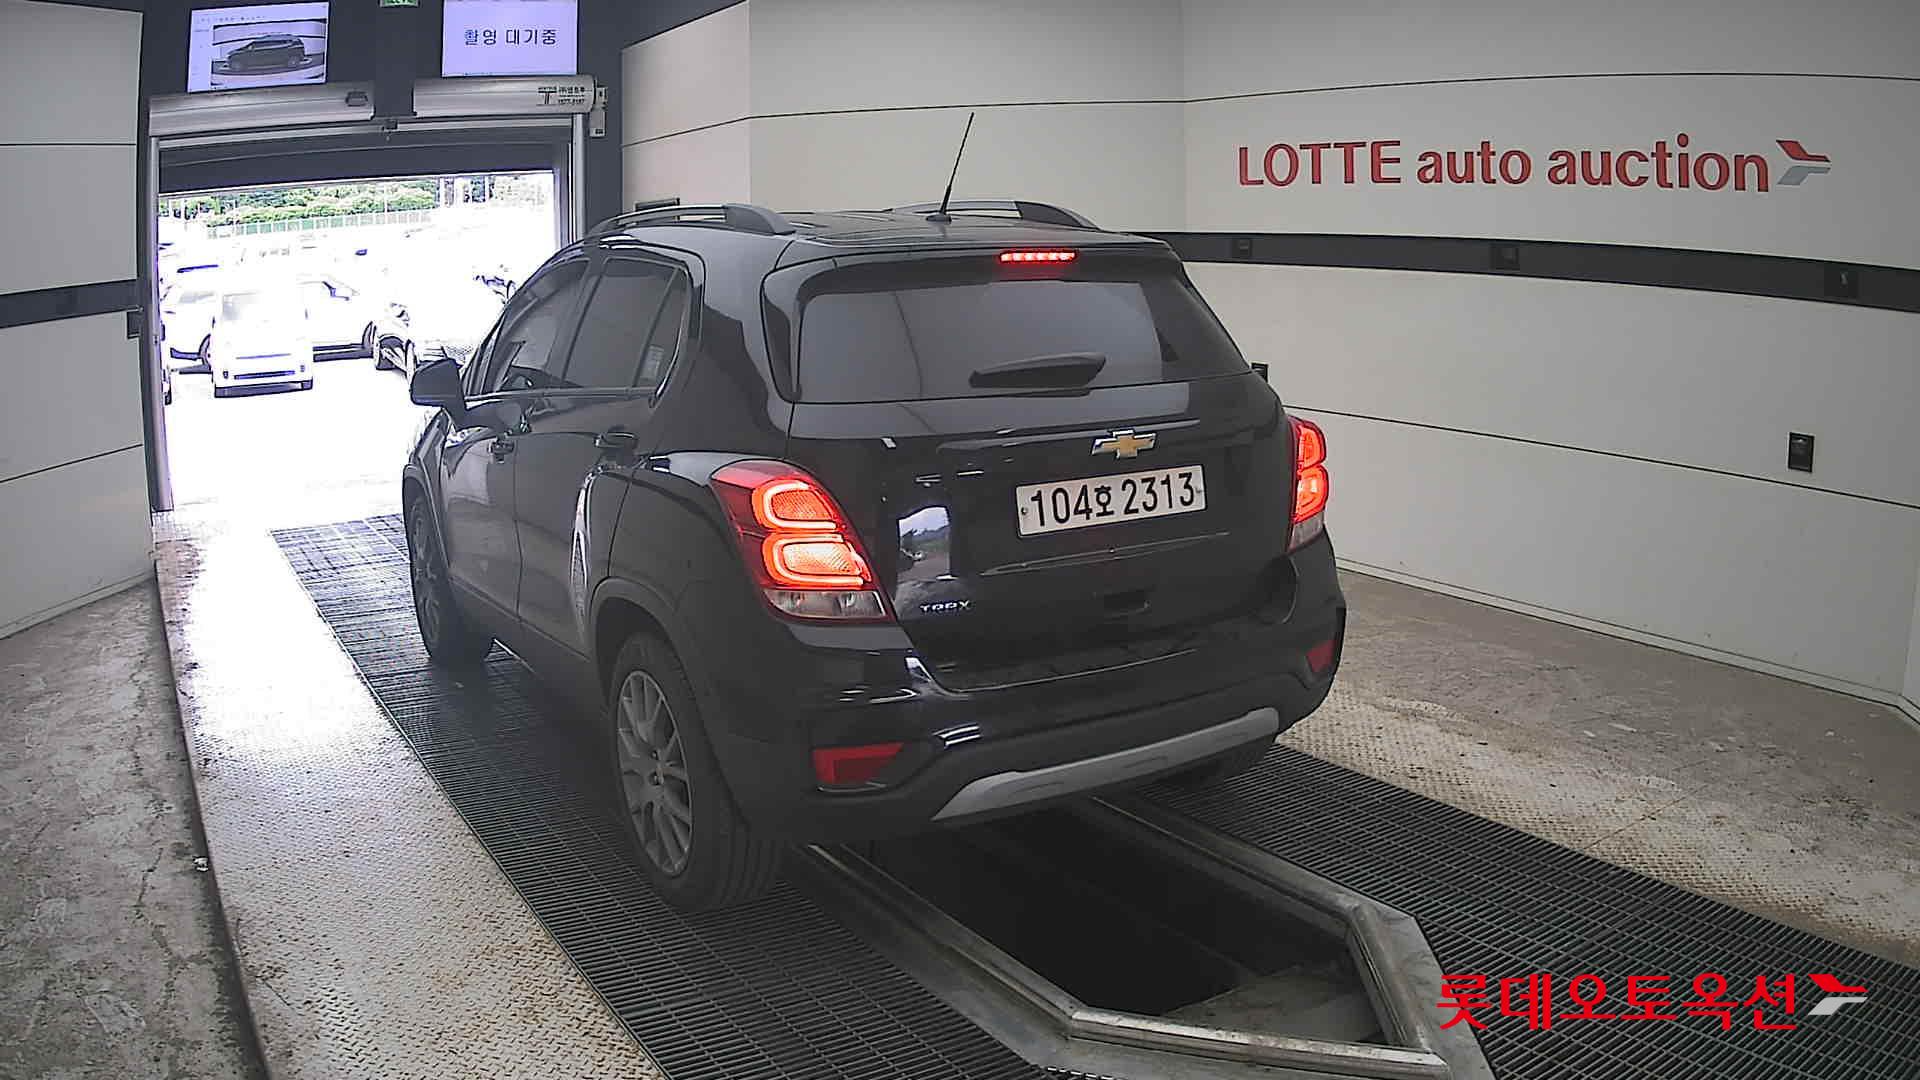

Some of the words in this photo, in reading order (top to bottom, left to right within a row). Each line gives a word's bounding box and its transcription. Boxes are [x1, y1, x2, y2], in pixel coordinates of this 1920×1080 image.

[465, 29, 497, 46] 촬영
[506, 29, 557, 46] 대기중
[1240, 140, 1402, 186] LOTTE
[1416, 140, 1533, 185] auto
[1547, 133, 1769, 193] auction
[1031, 484, 1114, 527] 104호
[1121, 472, 1195, 515] 2313
